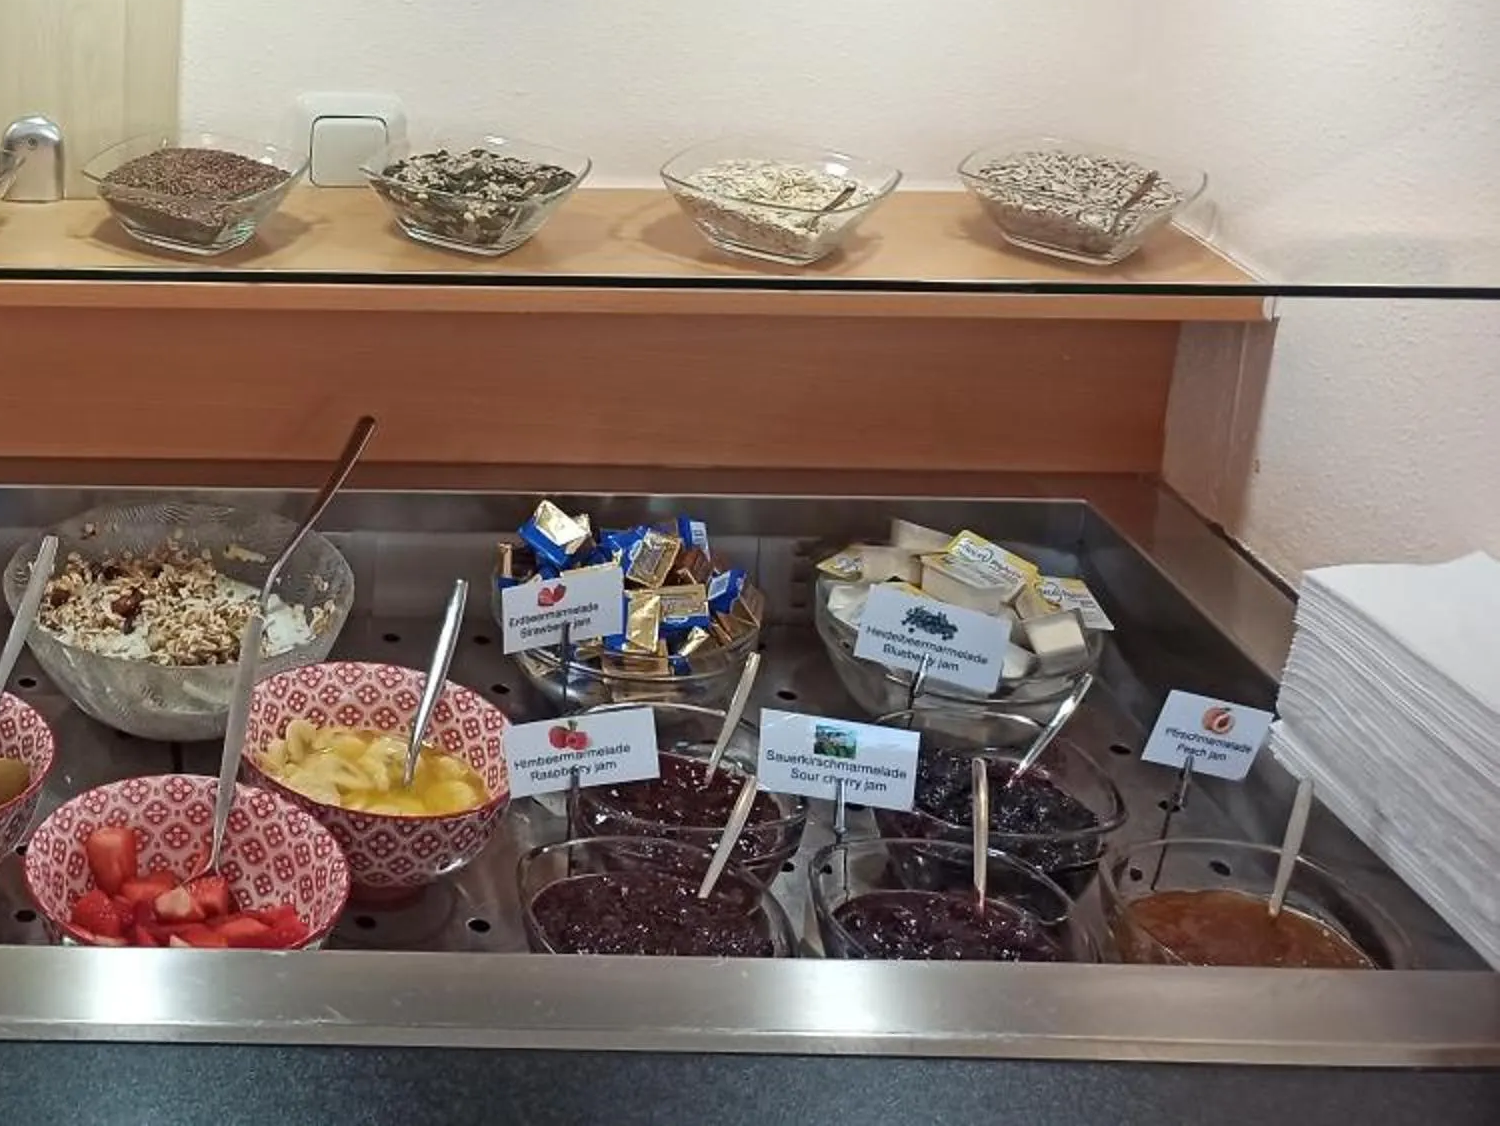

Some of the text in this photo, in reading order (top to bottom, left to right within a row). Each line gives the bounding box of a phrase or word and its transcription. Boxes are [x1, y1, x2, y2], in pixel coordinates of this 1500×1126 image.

[866, 624, 988, 664] Heidelbeermarmelade
[513, 742, 631, 771] Himbeermarmelade
[594, 758, 618, 774] jam
[765, 749, 907, 779] Sauerkirschmarmelade
[790, 766, 821, 782] Sour
[863, 779, 888, 793] jam
